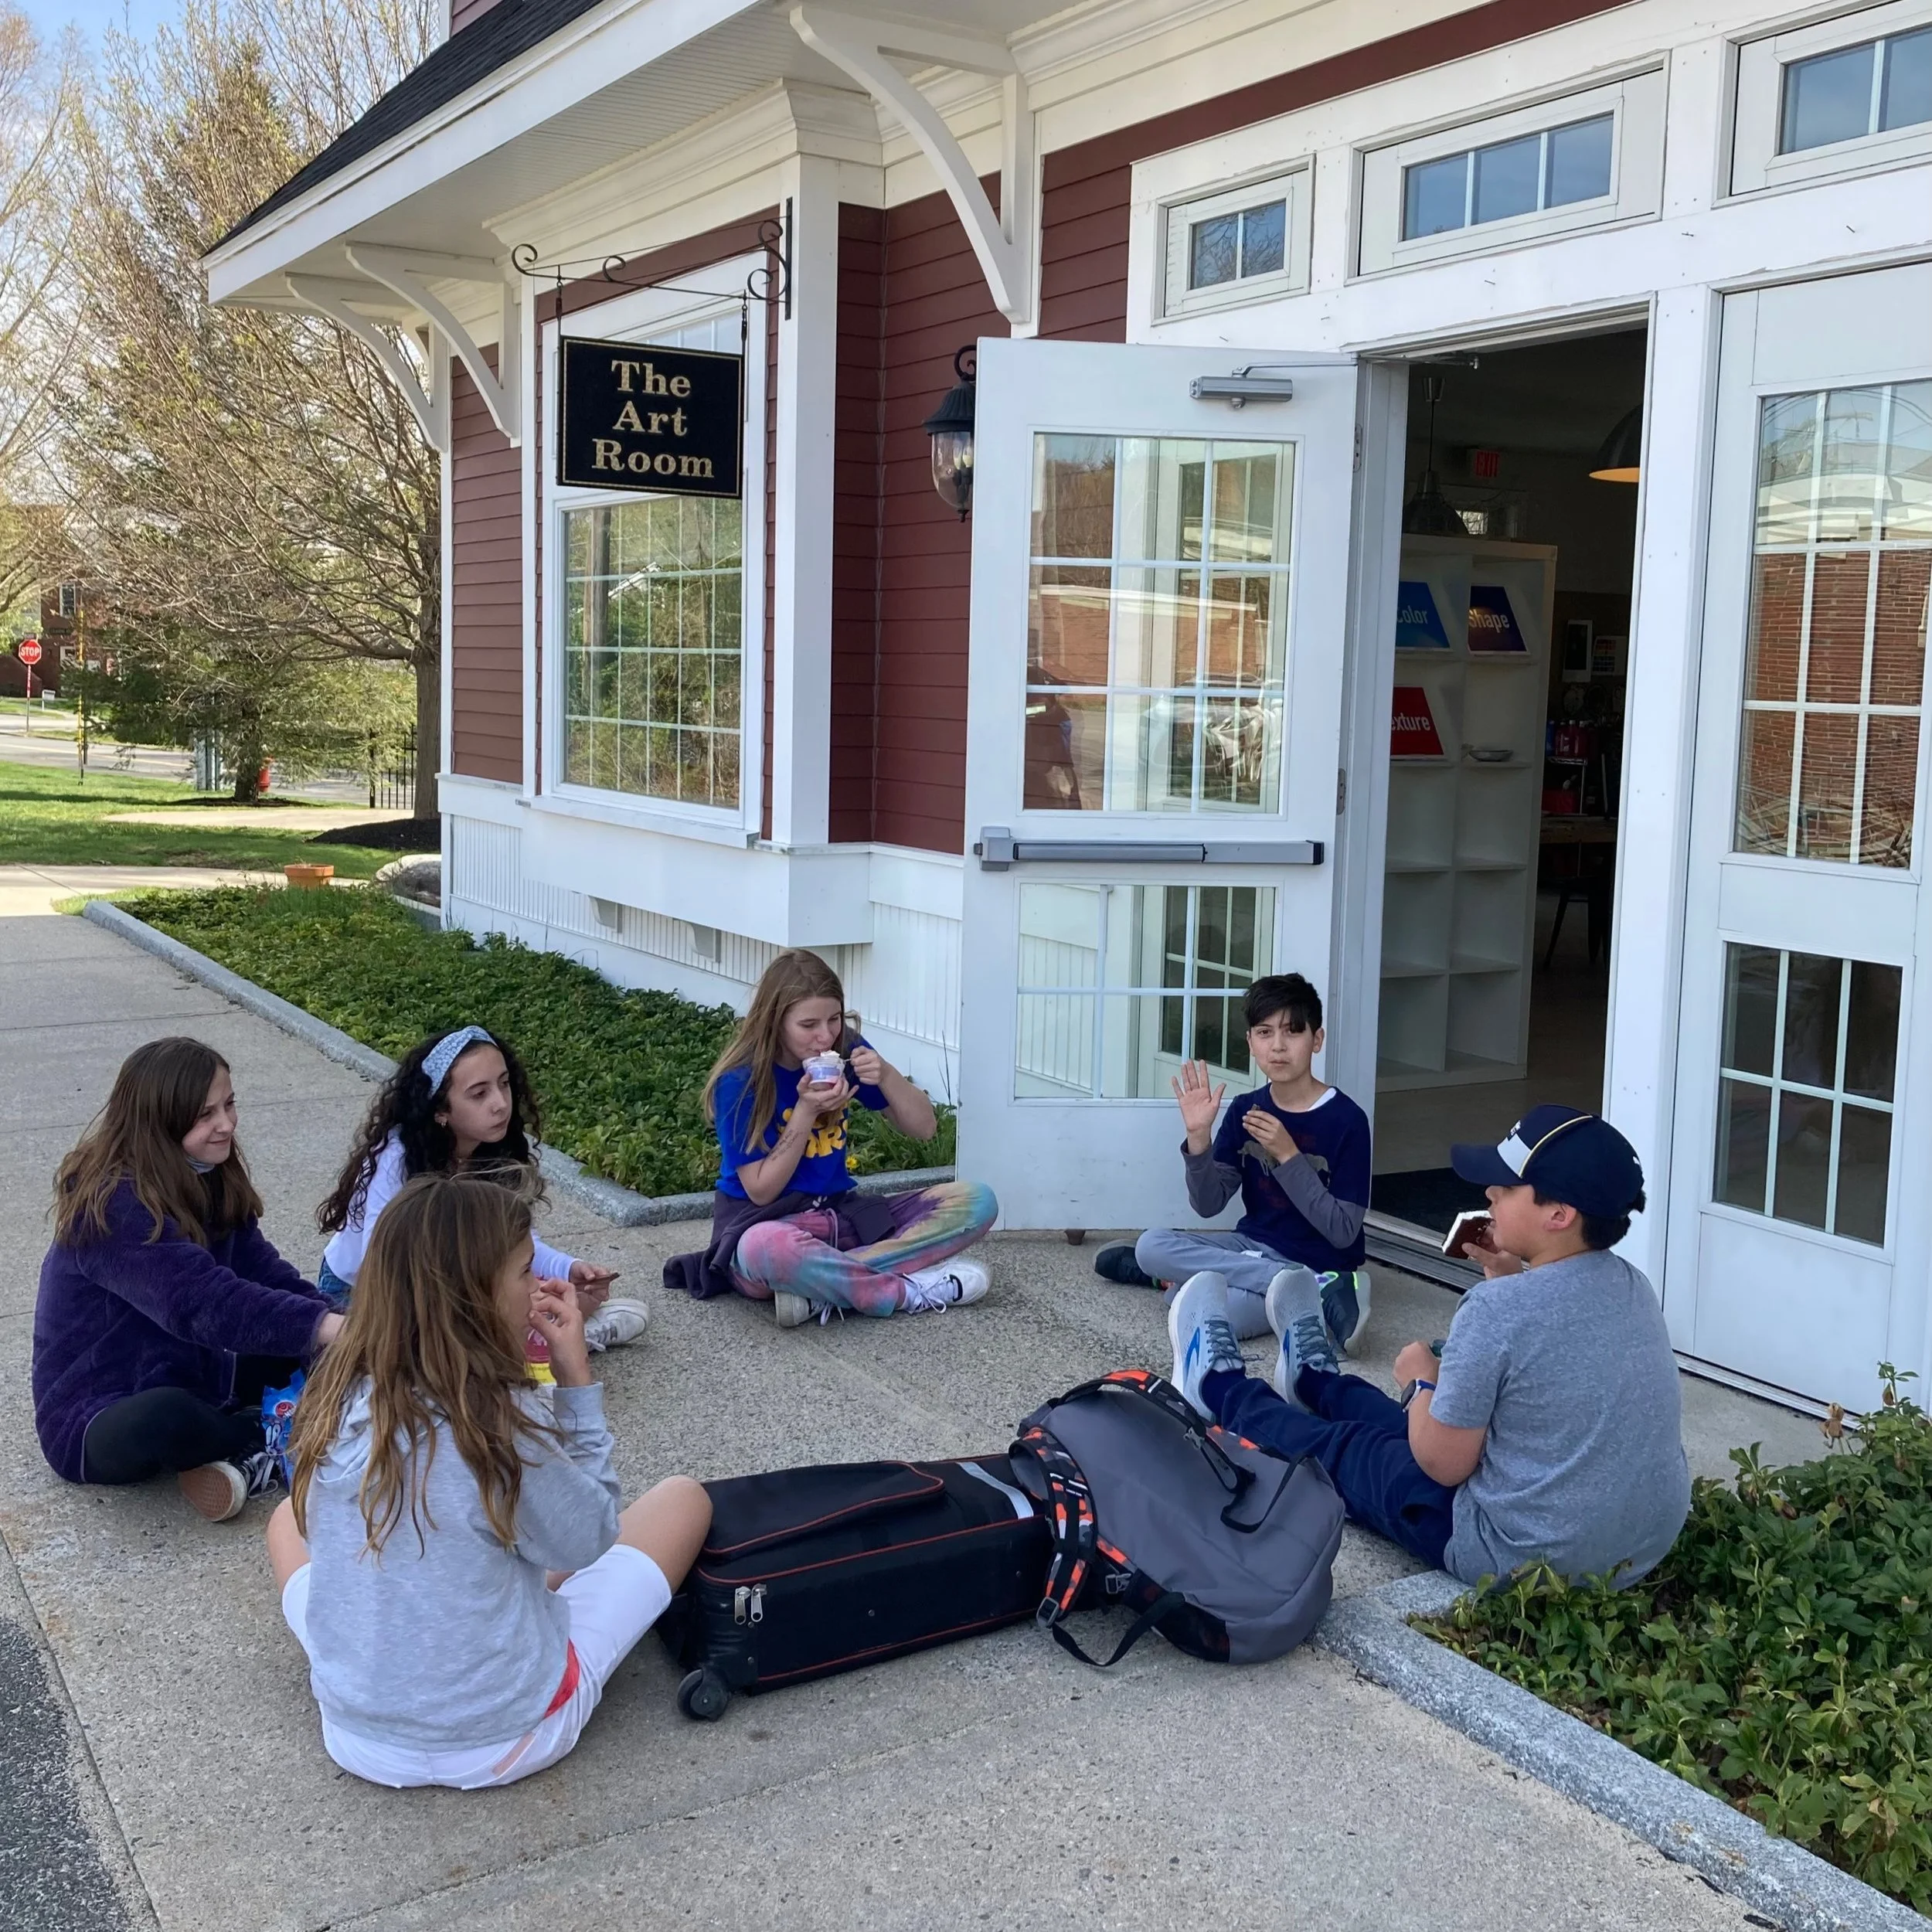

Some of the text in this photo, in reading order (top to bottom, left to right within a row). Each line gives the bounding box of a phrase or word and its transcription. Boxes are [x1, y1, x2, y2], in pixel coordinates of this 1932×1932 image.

[611, 359, 692, 397] The
[612, 400, 688, 437] Art
[591, 438, 714, 478] Room
[20, 646, 39, 656] STOP
